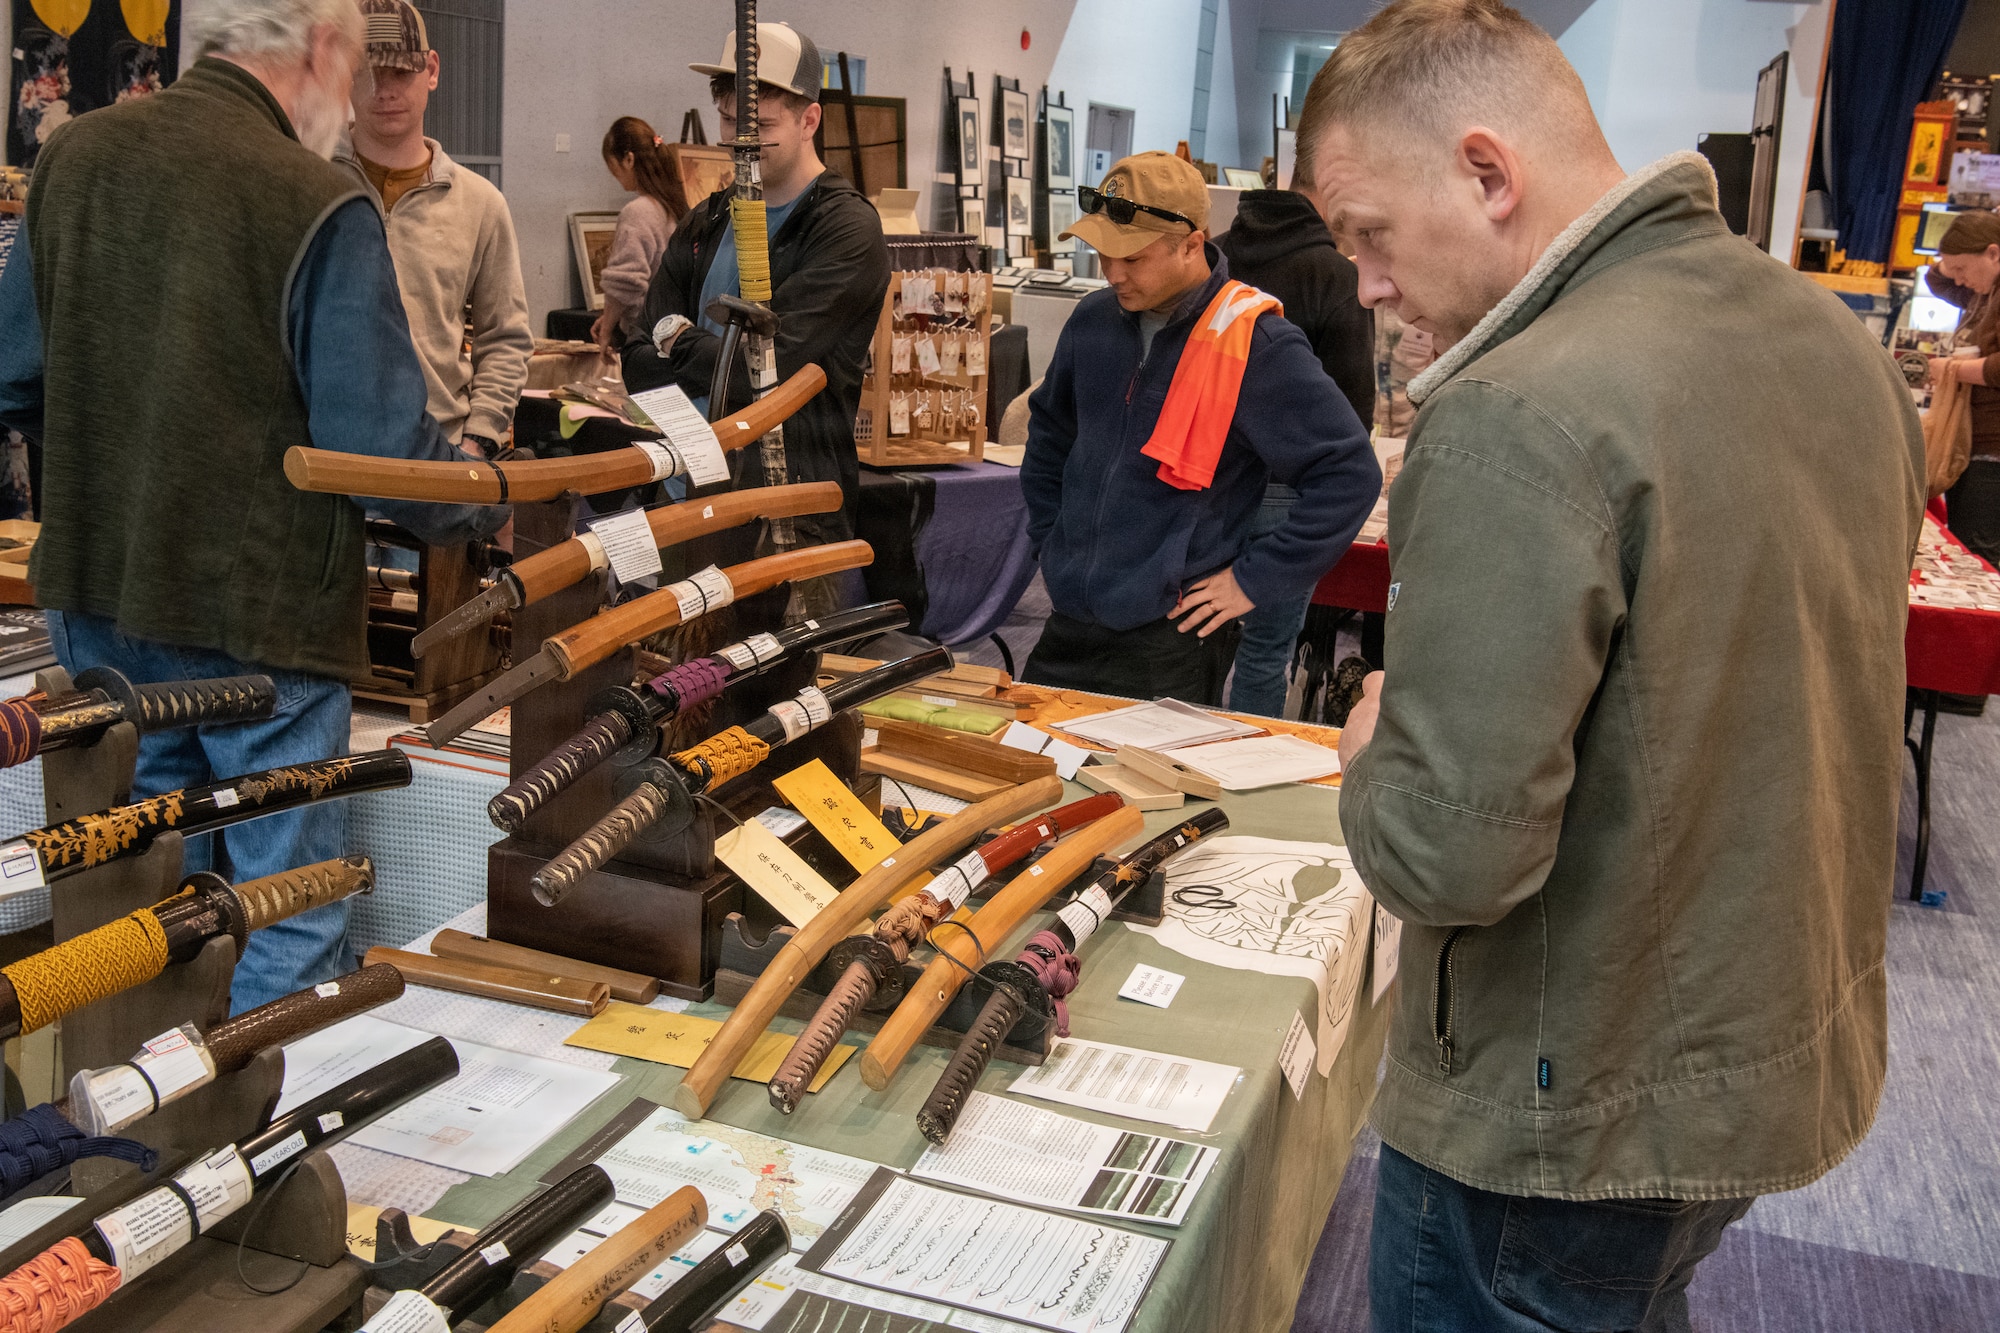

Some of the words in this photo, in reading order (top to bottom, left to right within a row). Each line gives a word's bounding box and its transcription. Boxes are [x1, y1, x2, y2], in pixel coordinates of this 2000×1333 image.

[1131, 979, 1146, 994] Please
[1140, 971, 1152, 980] Ask
[1143, 983, 1159, 997] Before
[1155, 975, 1164, 984] you
[1160, 983, 1173, 995] touch
[253, 1159, 267, 1171] 450
[270, 1144, 291, 1160] YEARS
[289, 1136, 305, 1149] OLD
[129, 1222, 144, 1233] Forged
[401, 1302, 410, 1310] given
[398, 1310, 410, 1320] allowed
